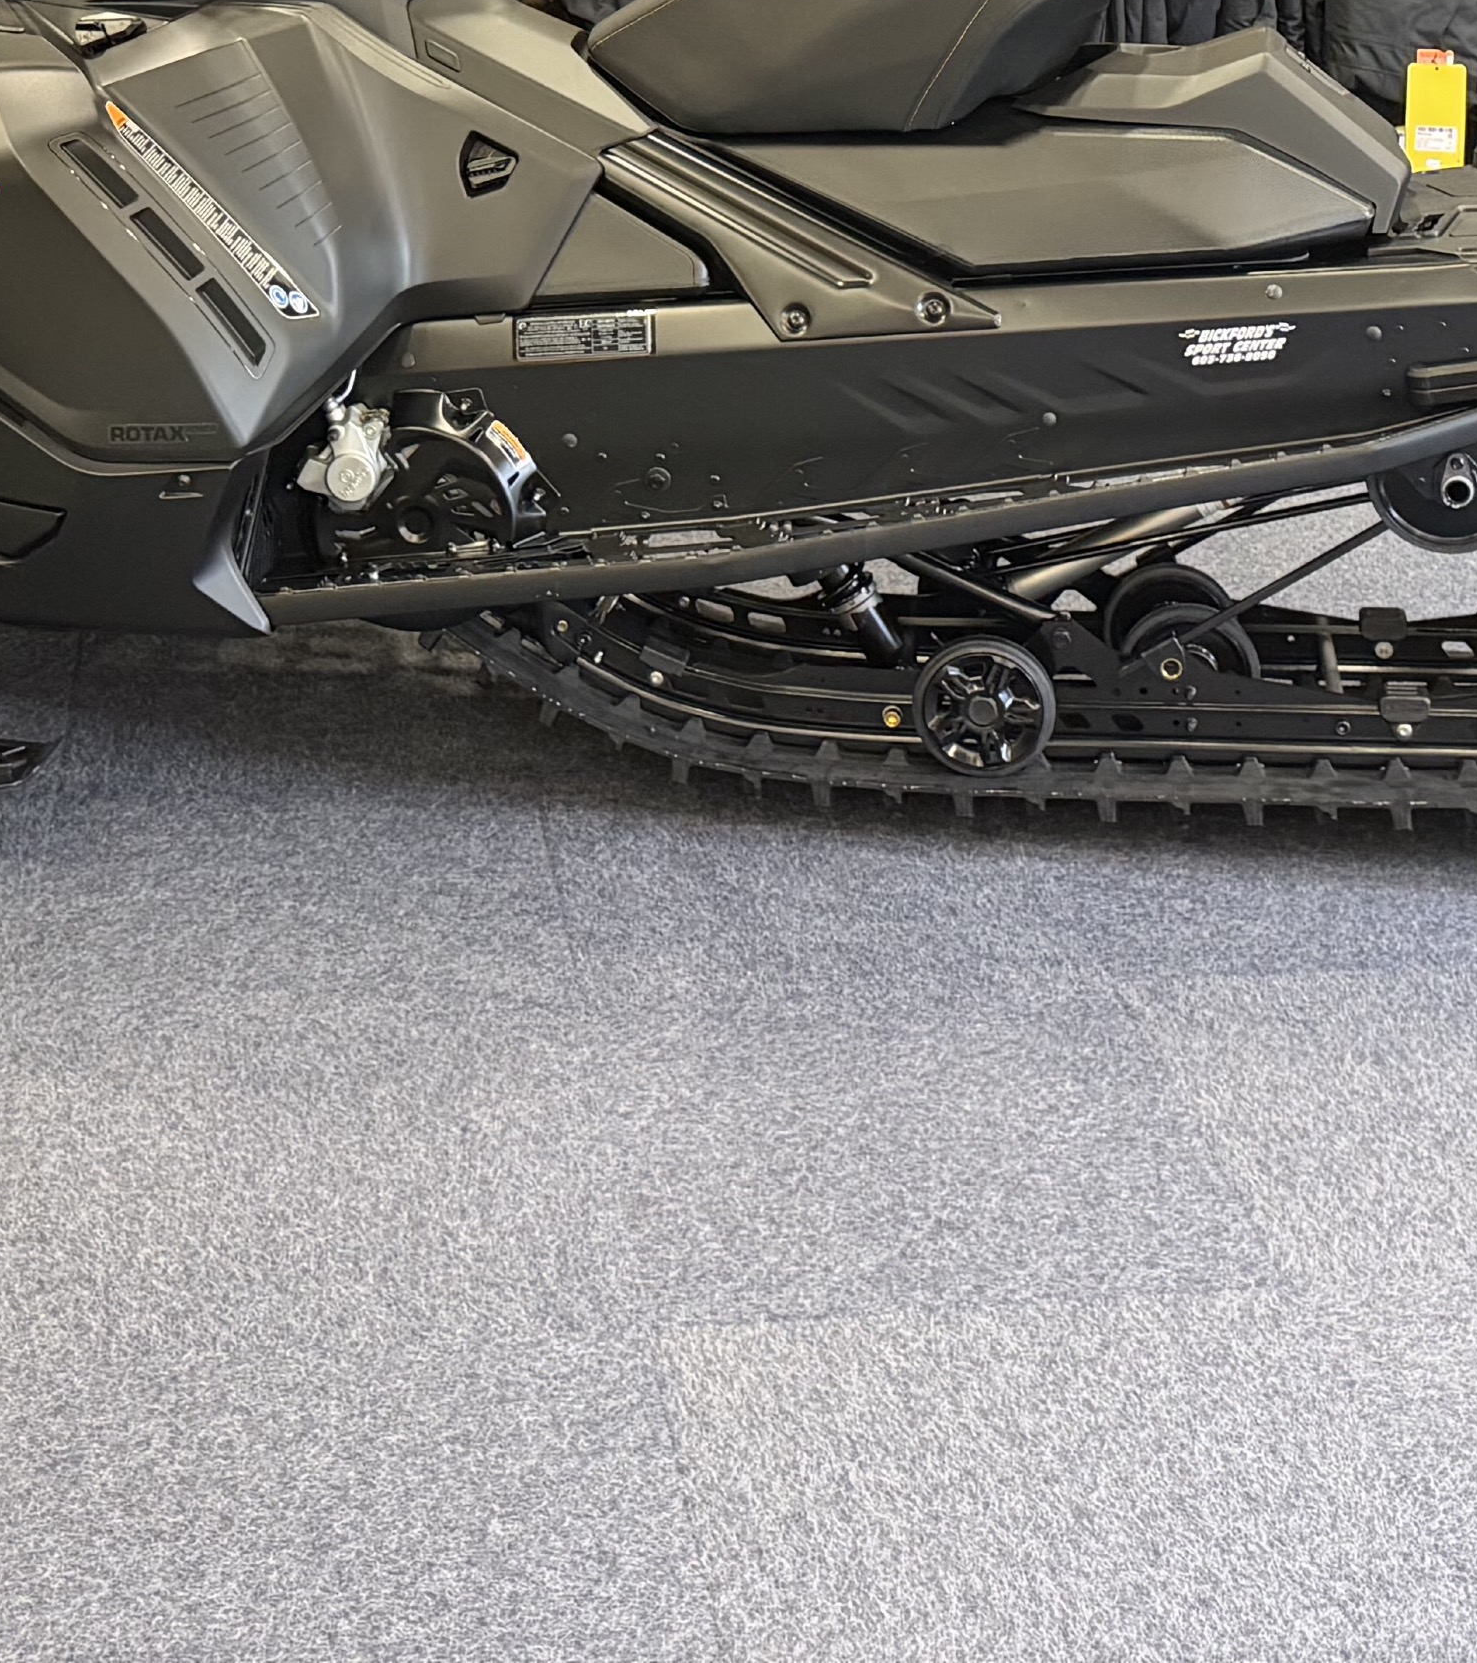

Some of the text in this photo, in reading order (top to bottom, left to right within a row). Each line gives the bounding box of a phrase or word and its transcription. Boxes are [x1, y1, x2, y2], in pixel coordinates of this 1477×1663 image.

[1184, 337, 1287, 357] SPORT CENTER
[109, 425, 187, 443] ROTAX
